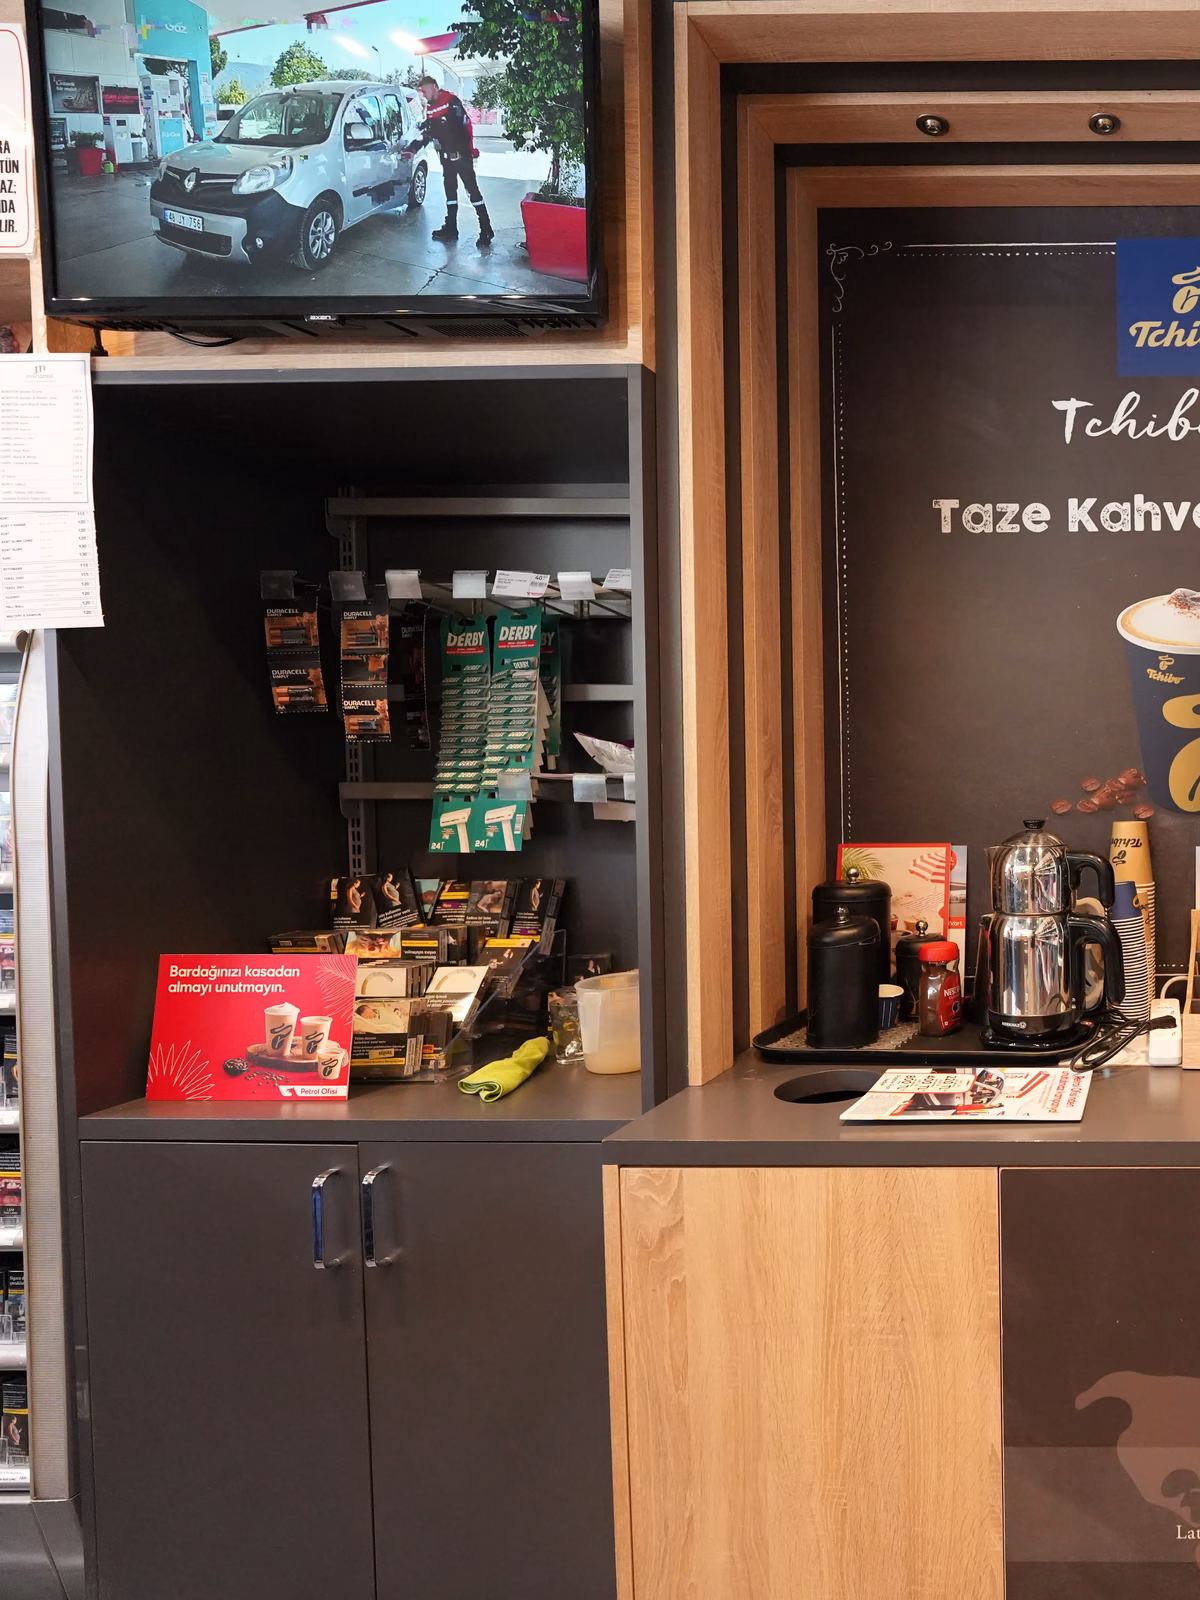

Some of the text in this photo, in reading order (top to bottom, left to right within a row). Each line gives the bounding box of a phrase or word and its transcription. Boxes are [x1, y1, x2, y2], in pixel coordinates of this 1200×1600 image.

[932, 498, 1051, 534] Taze
[447, 631, 485, 648] DERBY
[499, 624, 538, 641] DERBY
[512, 660, 530, 669] DERBY
[1146, 668, 1186, 685] Tchibo
[431, 842, 441, 850] 24
[475, 839, 486, 847] 24
[1111, 837, 1143, 848] Tchib
[169, 965, 300, 980] Bardağınızı kasadan
[168, 981, 286, 996] almayı unutmayın.
[300, 1087, 338, 1095] Petrol Ofisi
